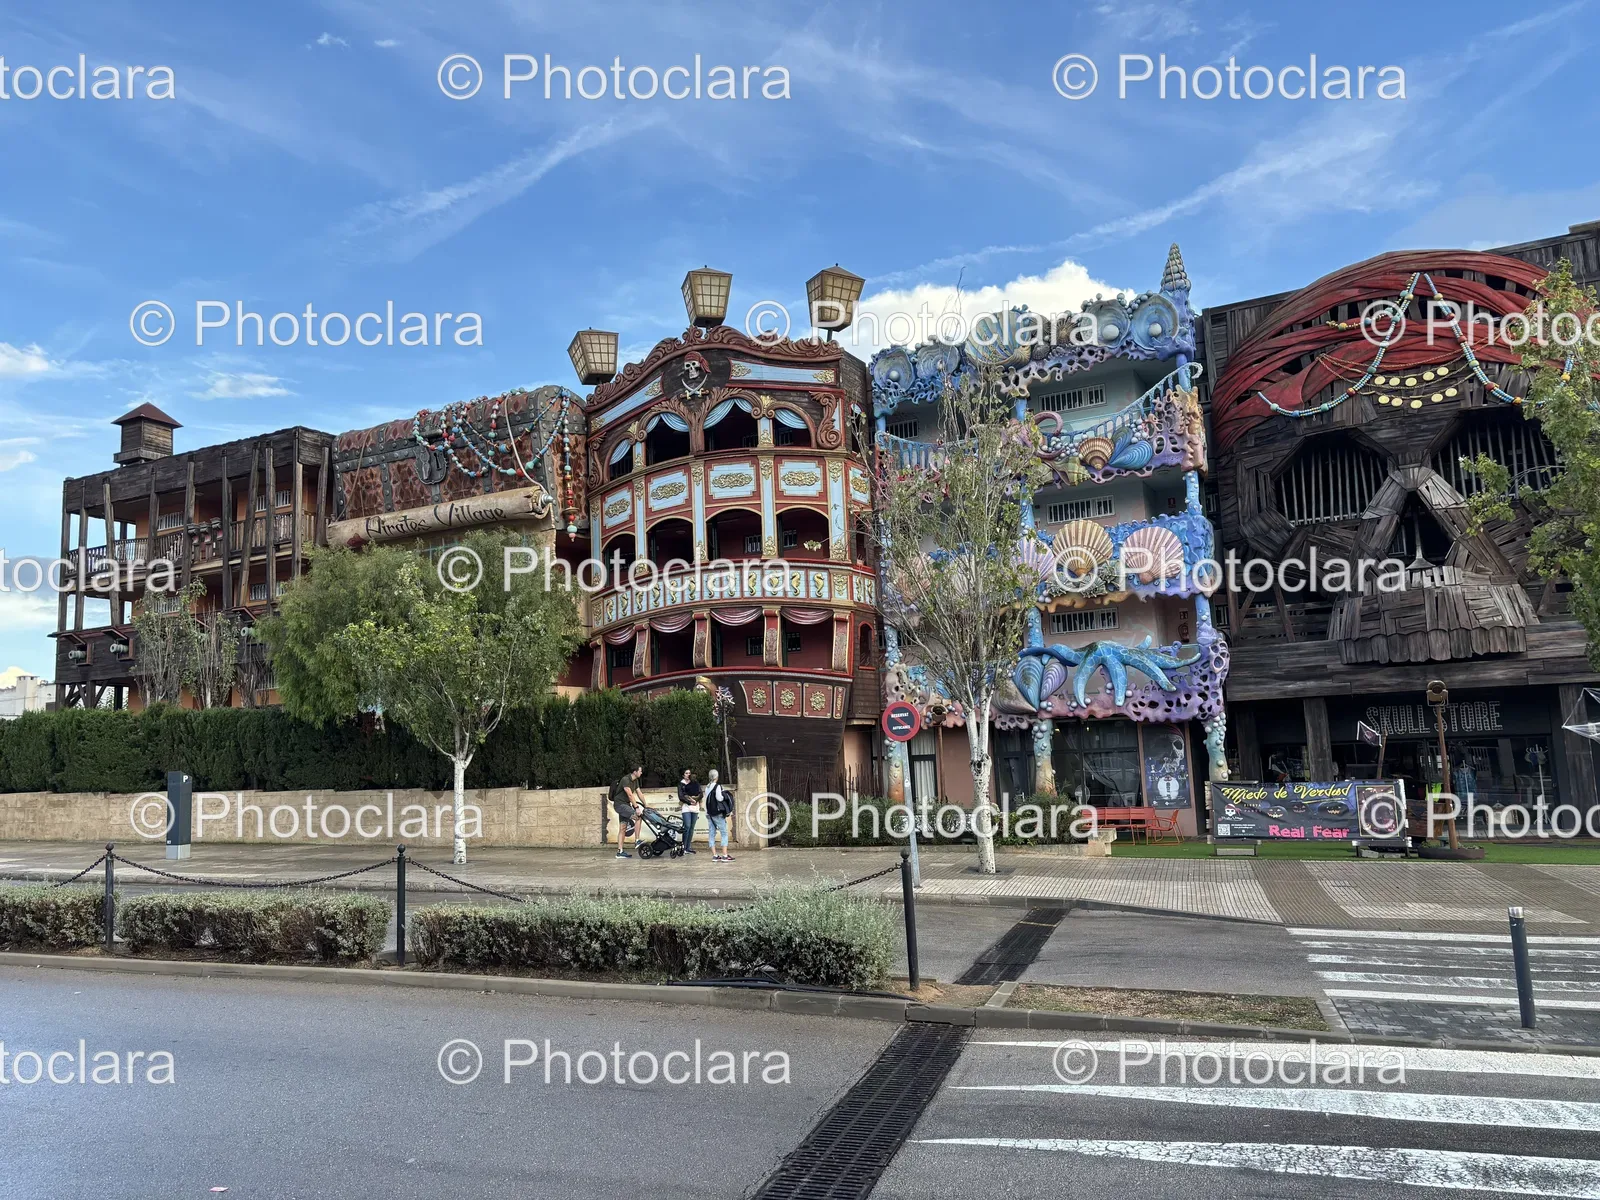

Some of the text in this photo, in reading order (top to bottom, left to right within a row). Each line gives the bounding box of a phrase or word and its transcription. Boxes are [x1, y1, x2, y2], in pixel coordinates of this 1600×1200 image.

[365, 503, 506, 538] Pirates Village
[1366, 701, 1503, 735] SKULL STORE
[1221, 783, 1353, 804] Miedo de Verdad
[1268, 824, 1350, 838] Real Fear
